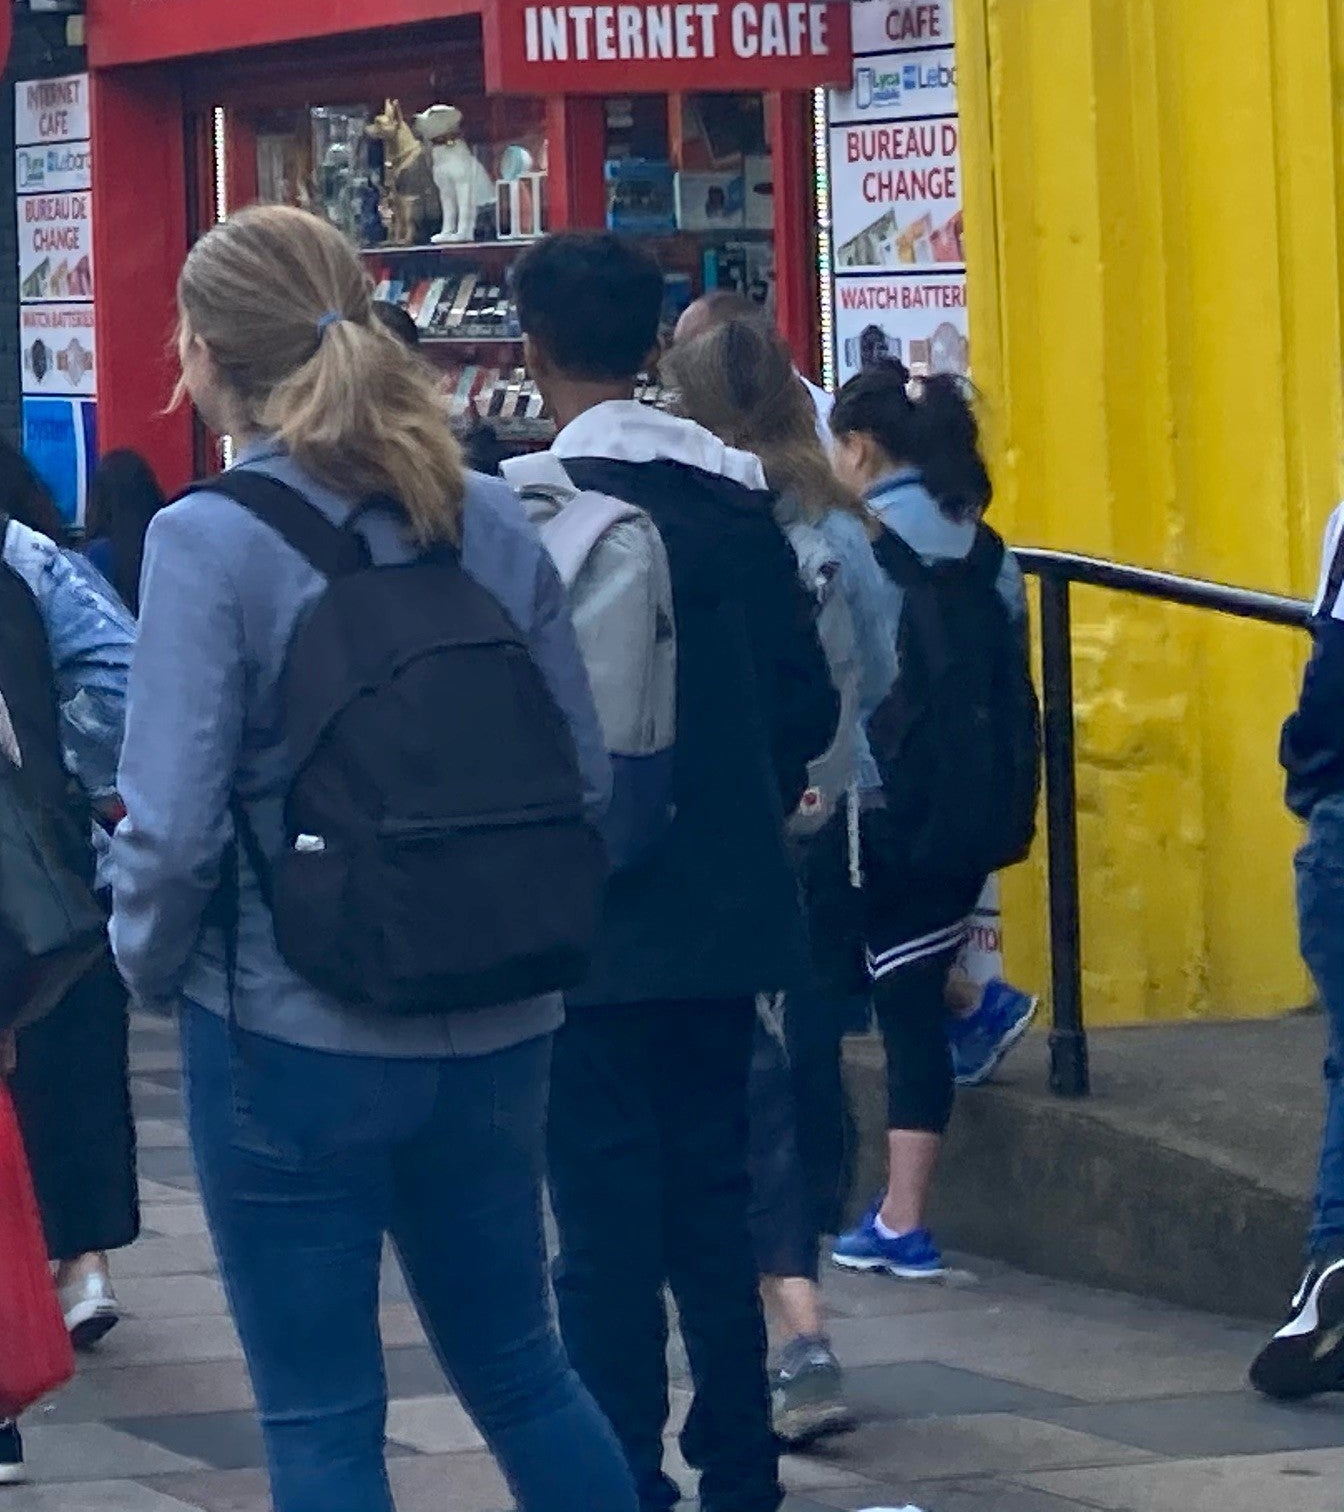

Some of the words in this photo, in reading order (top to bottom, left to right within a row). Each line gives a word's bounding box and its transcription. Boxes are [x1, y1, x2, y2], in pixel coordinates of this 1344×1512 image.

[525, 3, 719, 63] INTERNET
[731, 2, 830, 60] CAFE
[886, 3, 941, 42] CAFE
[39, 111, 69, 138] CAFE
[847, 126, 936, 164] BUREAU
[862, 166, 956, 203] CHANGE
[25, 197, 72, 223] BUREAU
[72, 196, 88, 220] DE
[32, 226, 80, 253] CHANGE
[841, 286, 899, 310] WATCH
